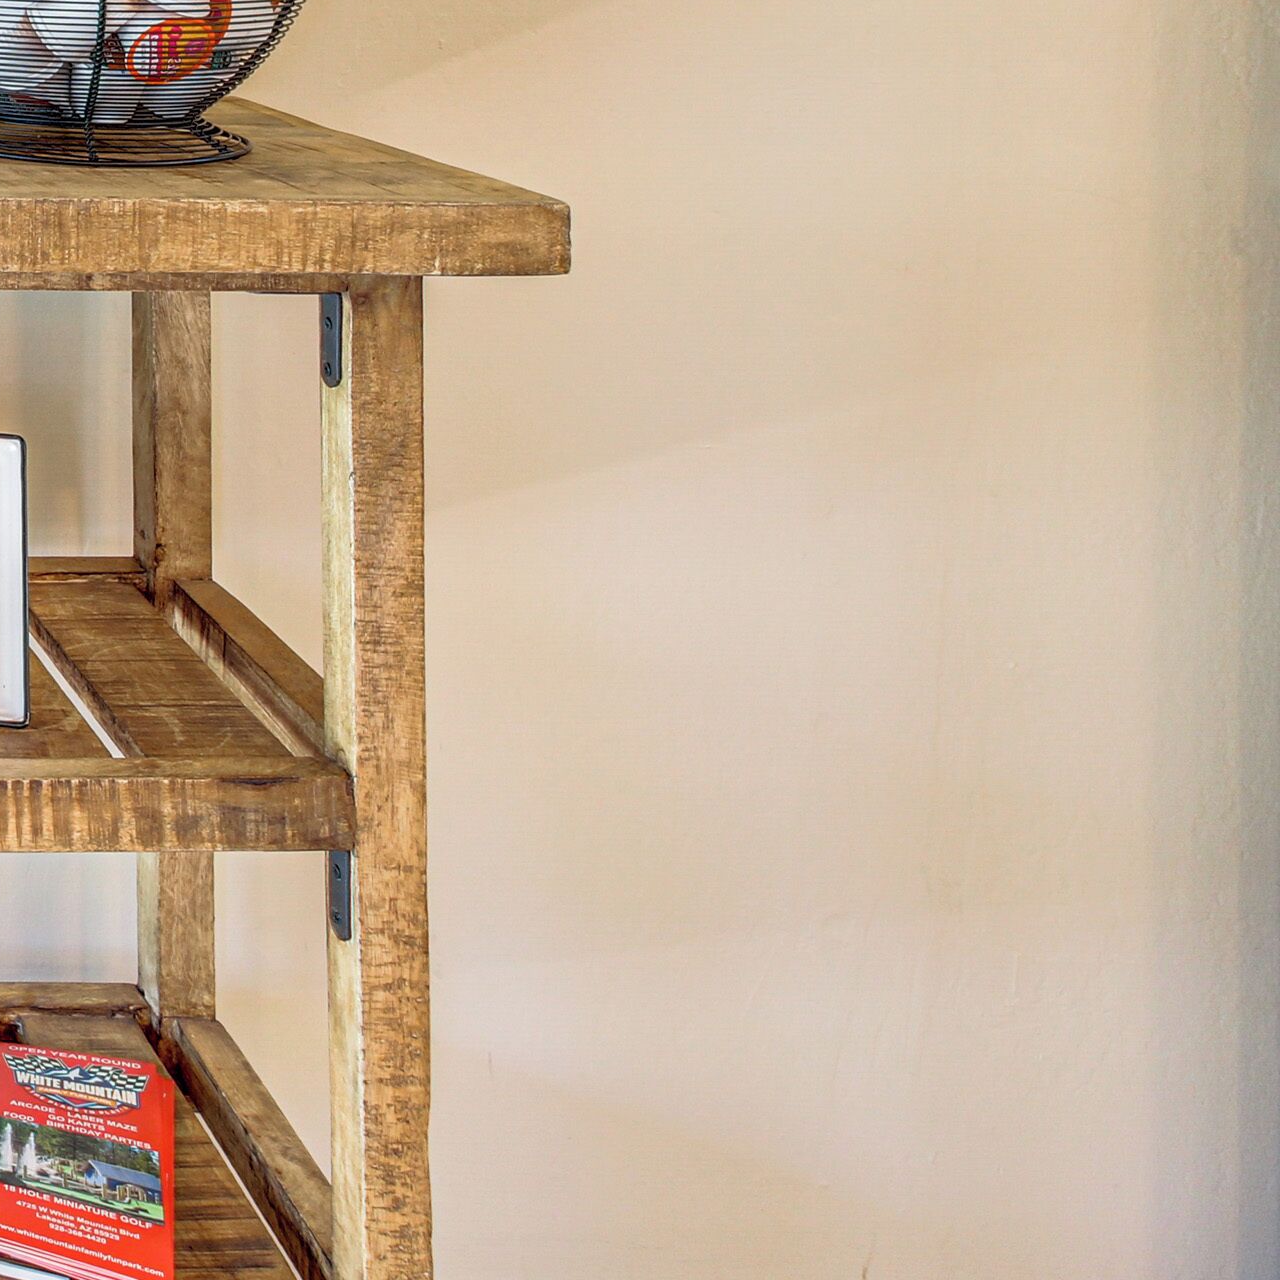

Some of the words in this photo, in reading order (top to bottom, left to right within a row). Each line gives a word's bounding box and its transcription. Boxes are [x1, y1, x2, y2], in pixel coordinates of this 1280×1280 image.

[8, 1045, 46, 1055] OPEN
[50, 1050, 87, 1061] YEAR
[91, 1057, 141, 1069] ROUND
[16, 1071, 60, 1088] WHITE
[63, 1081, 137, 1105] MOUNTAIN
[3, 1111, 35, 1122] FOOD
[48, 1114, 65, 1122] GO
[67, 1119, 105, 1131] KARTS
[10, 1100, 56, 1113] ARCADE
[67, 1112, 104, 1124] LASER
[107, 1120, 138, 1132] MAZE
[46, 1121, 101, 1137] BIRTHDAY
[104, 1132, 152, 1149] PARTIES
[4, 1184, 16, 1192] 18
[19, 1188, 51, 1202] HOLE
[54, 1196, 117, 1219] MINIATURE
[120, 1216, 153, 1229] GOLF
[16, 1200, 37, 1210] 4725
[50, 1208, 74, 1220] White
[76, 1217, 118, 1233] Mountain
[119, 1228, 140, 1239] Blvd
[36, 1212, 77, 1229] Lakeside,
[79, 1225, 92, 1233] AZ
